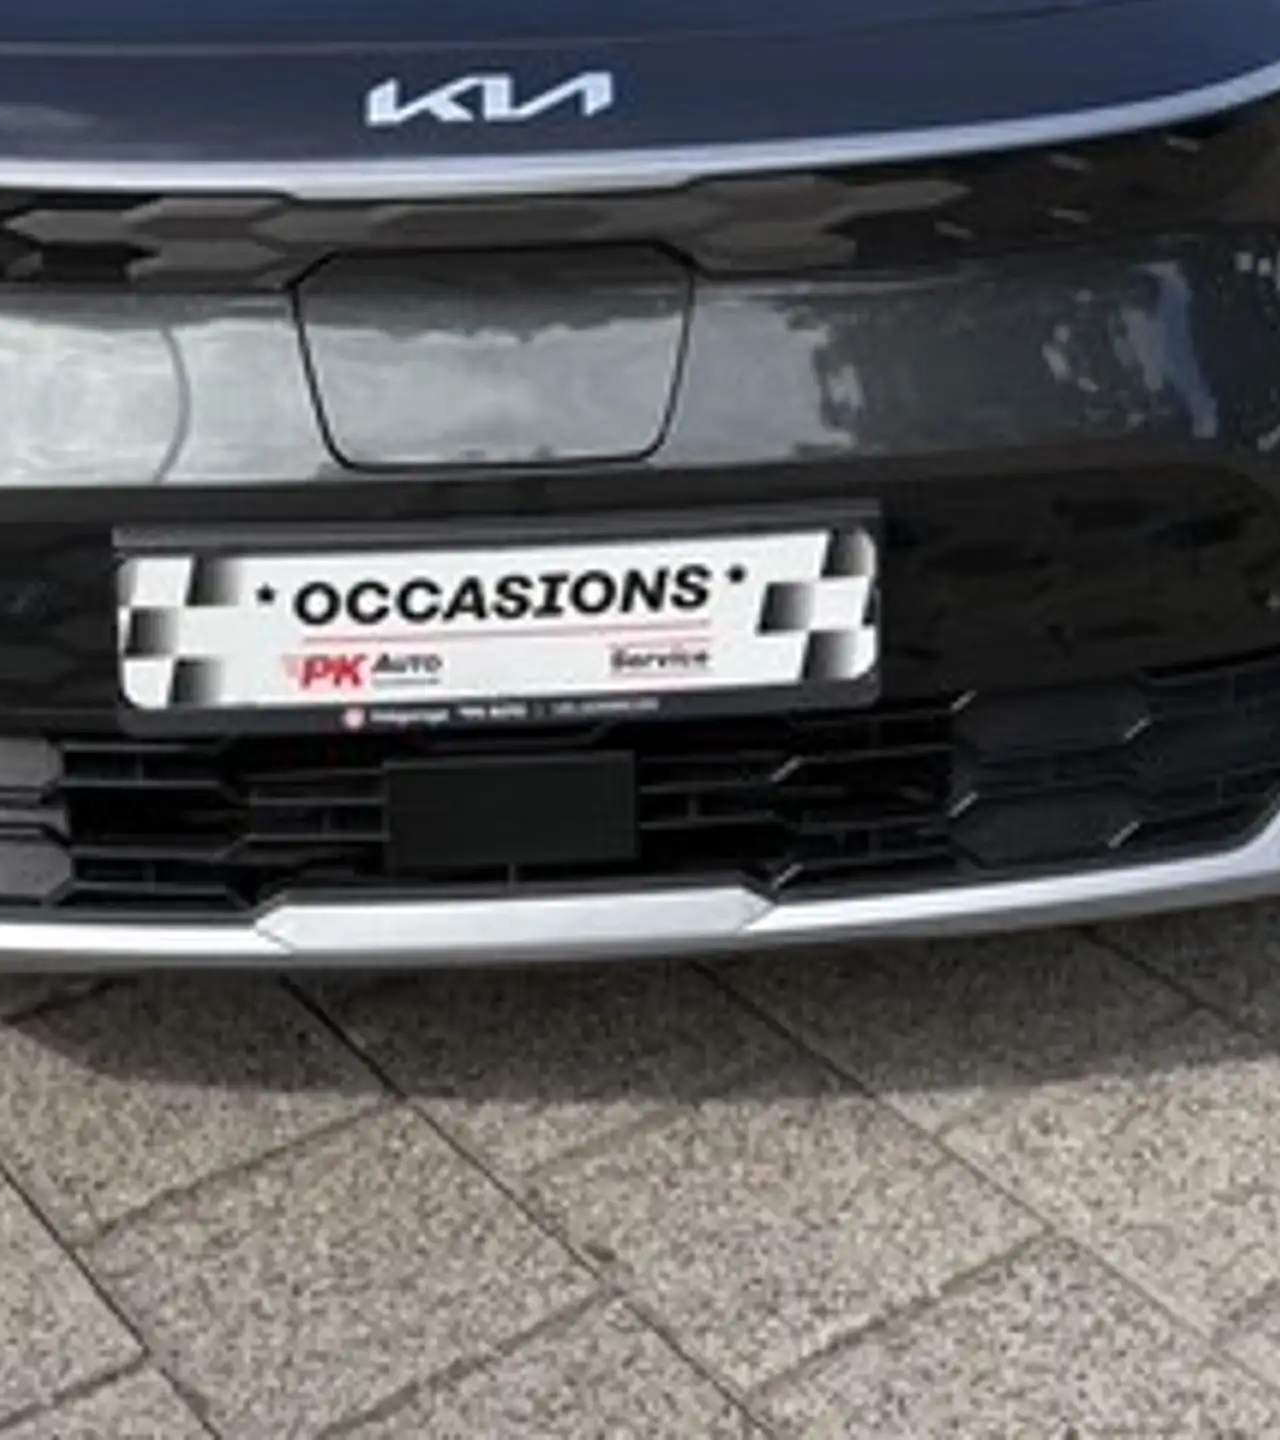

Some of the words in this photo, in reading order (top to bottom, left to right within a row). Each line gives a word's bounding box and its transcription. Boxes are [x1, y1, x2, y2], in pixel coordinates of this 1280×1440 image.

[365, 70, 613, 126] KIA
[293, 564, 711, 628] OCCASIONS
[299, 652, 368, 690] PK
[608, 644, 711, 671] Service
